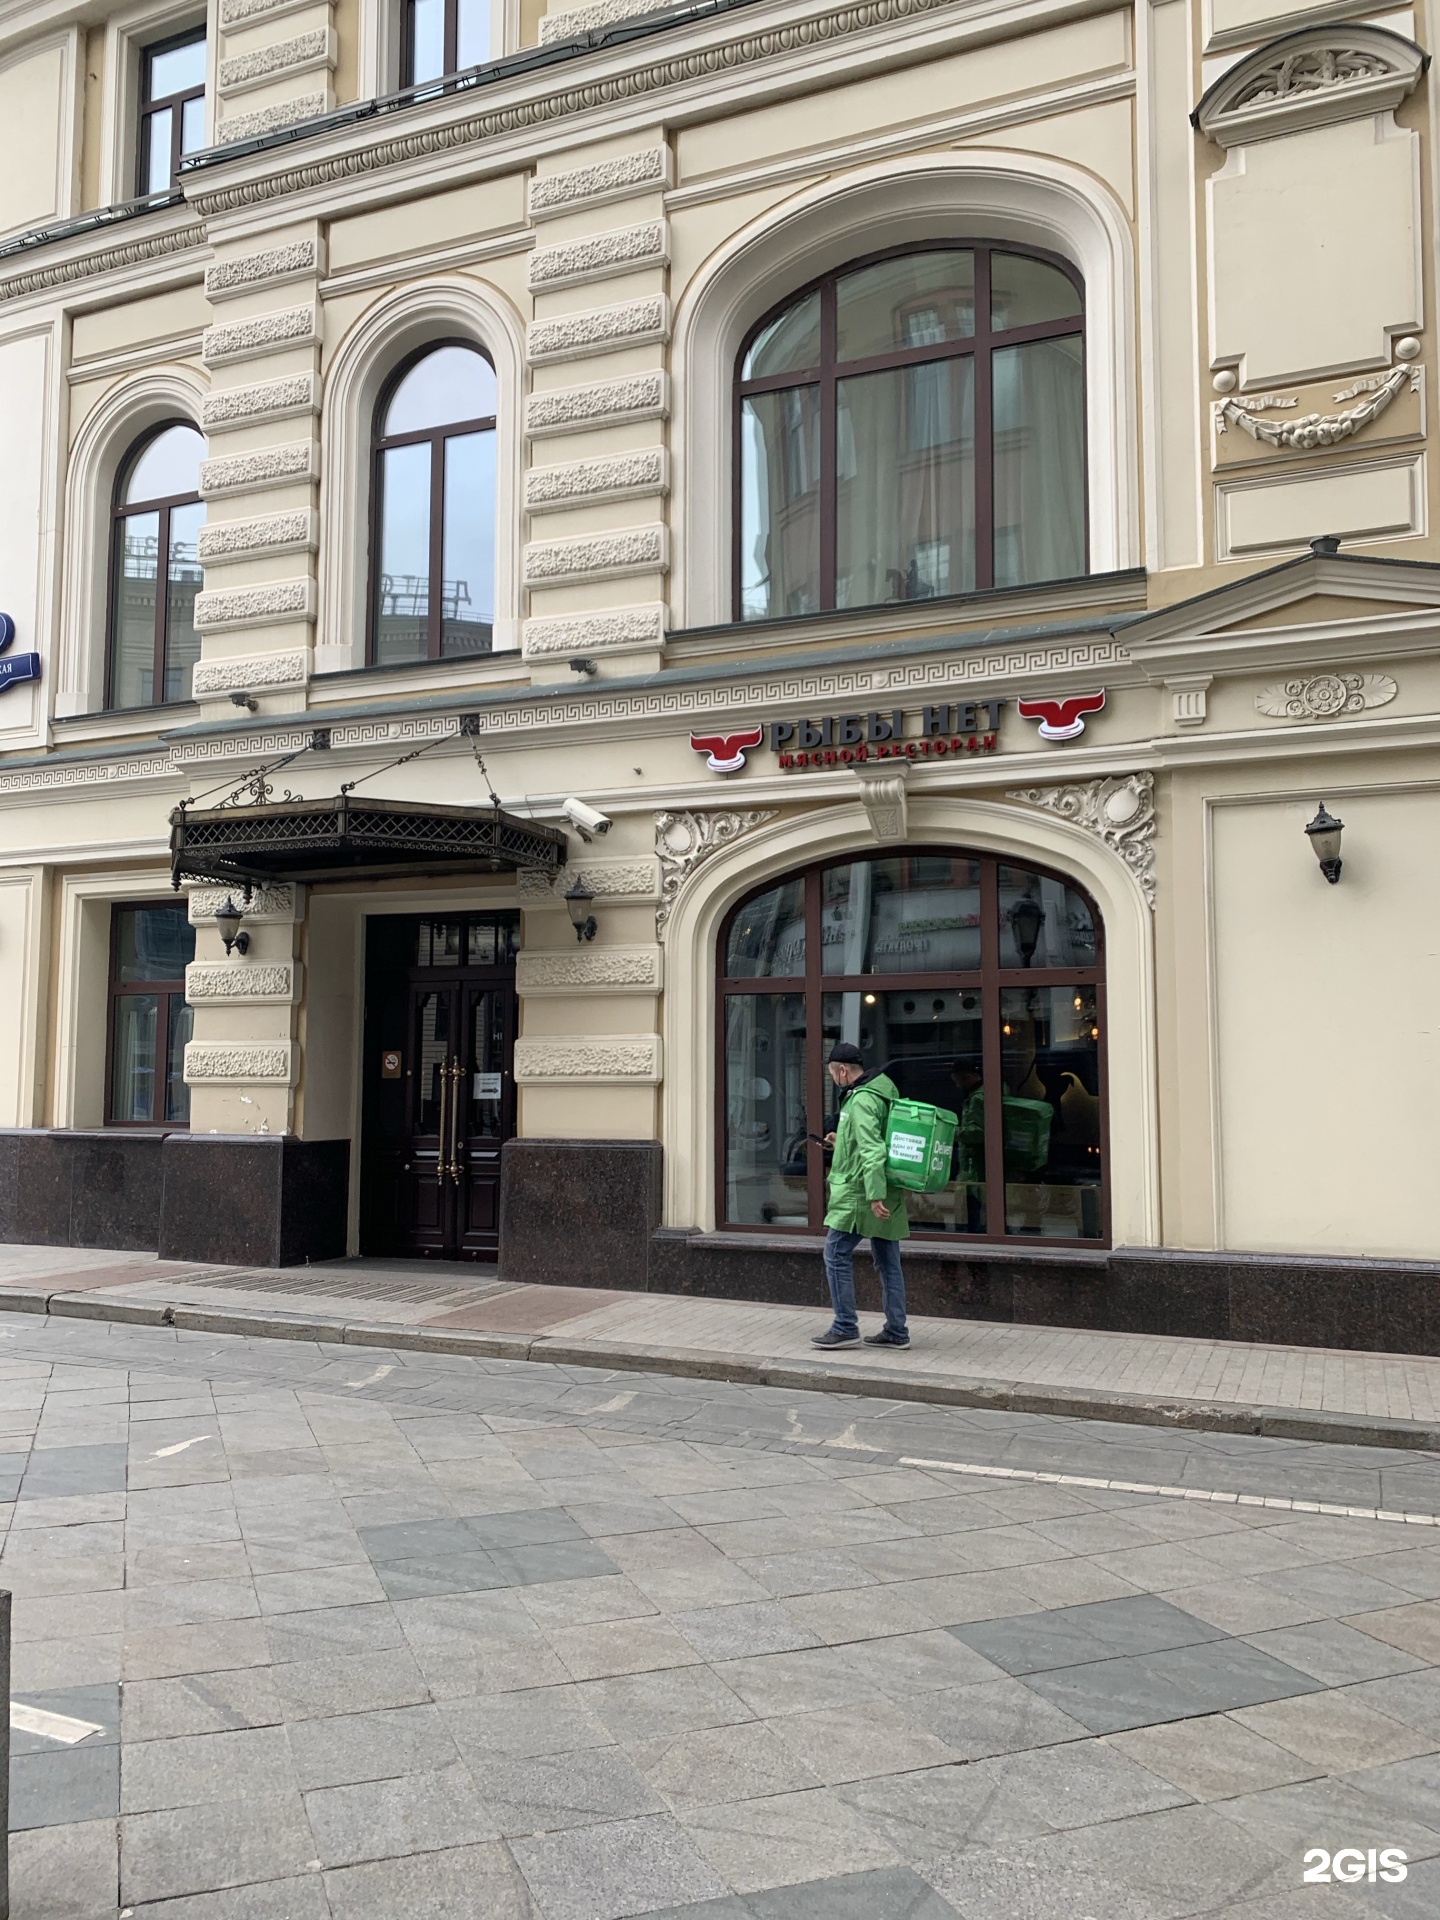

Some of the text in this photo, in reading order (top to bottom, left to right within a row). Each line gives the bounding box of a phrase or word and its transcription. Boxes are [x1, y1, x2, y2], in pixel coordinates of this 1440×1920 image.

[770, 698, 1007, 751] РЫБЫ НЕТ
[778, 734, 998, 770] МЯСНОЙ РЕСТОРАН
[893, 1135, 923, 1144] Доставка
[899, 1151, 919, 1160] минут
